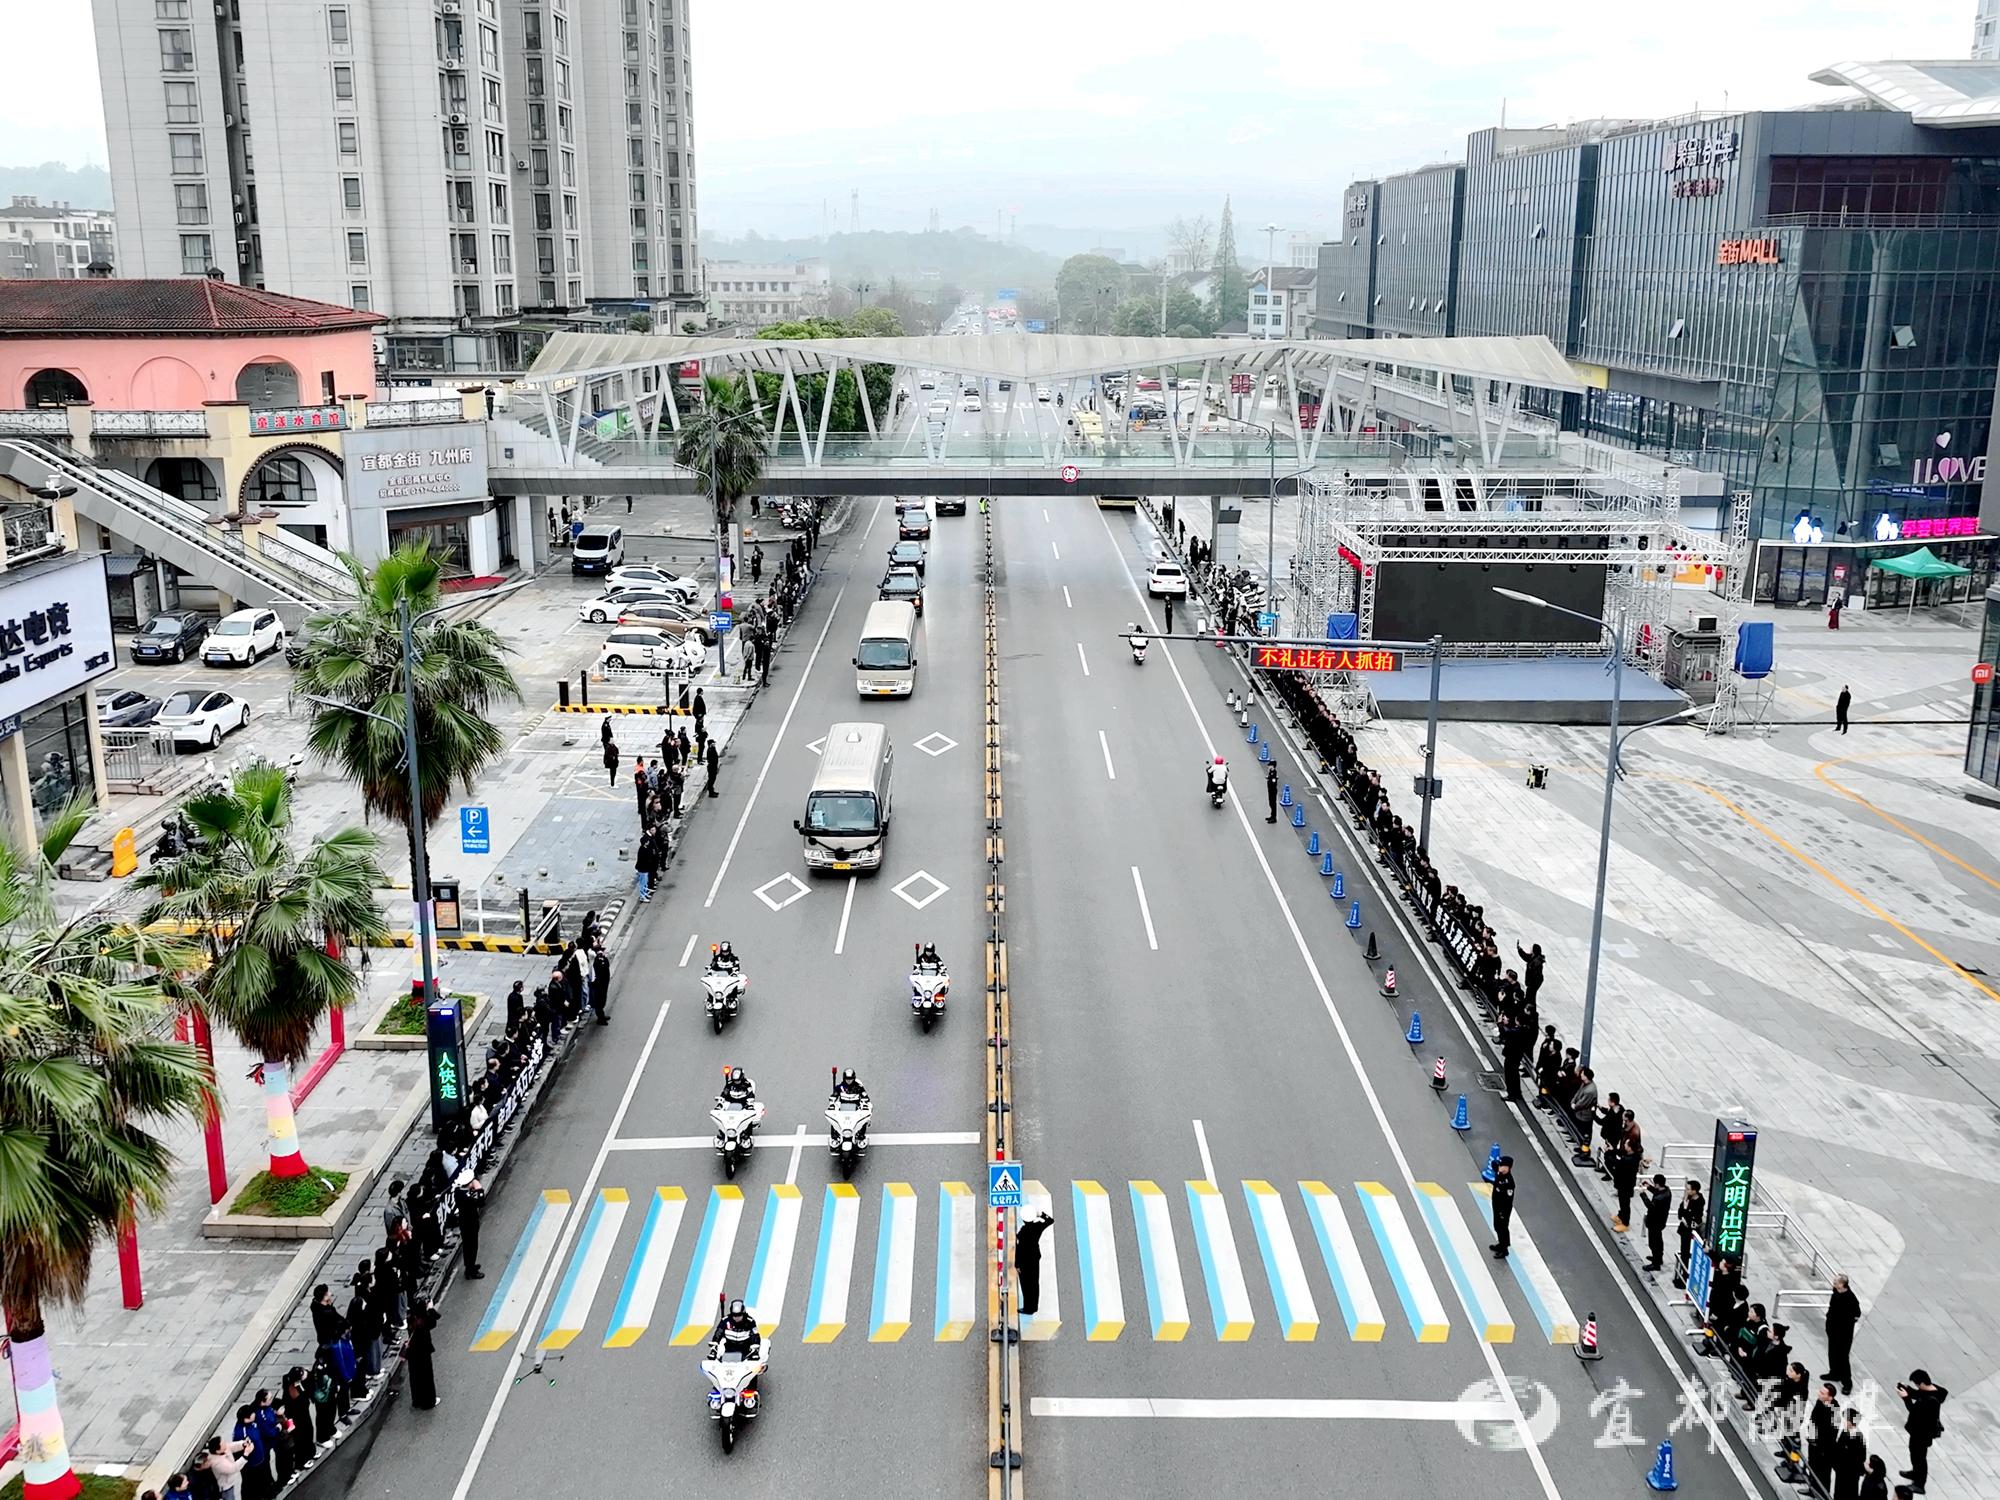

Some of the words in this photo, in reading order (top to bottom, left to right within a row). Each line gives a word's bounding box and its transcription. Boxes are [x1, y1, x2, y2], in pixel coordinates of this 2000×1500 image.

[362, 451, 421, 471] 宜都金街
[429, 447, 473, 466] 九州府
[24, 642, 74, 673] Esports
[1258, 648, 1394, 671] 不礼让行人抓拍
[438, 1051, 458, 1100] 人快走
[1718, 1162, 1750, 1252] 文明出行
